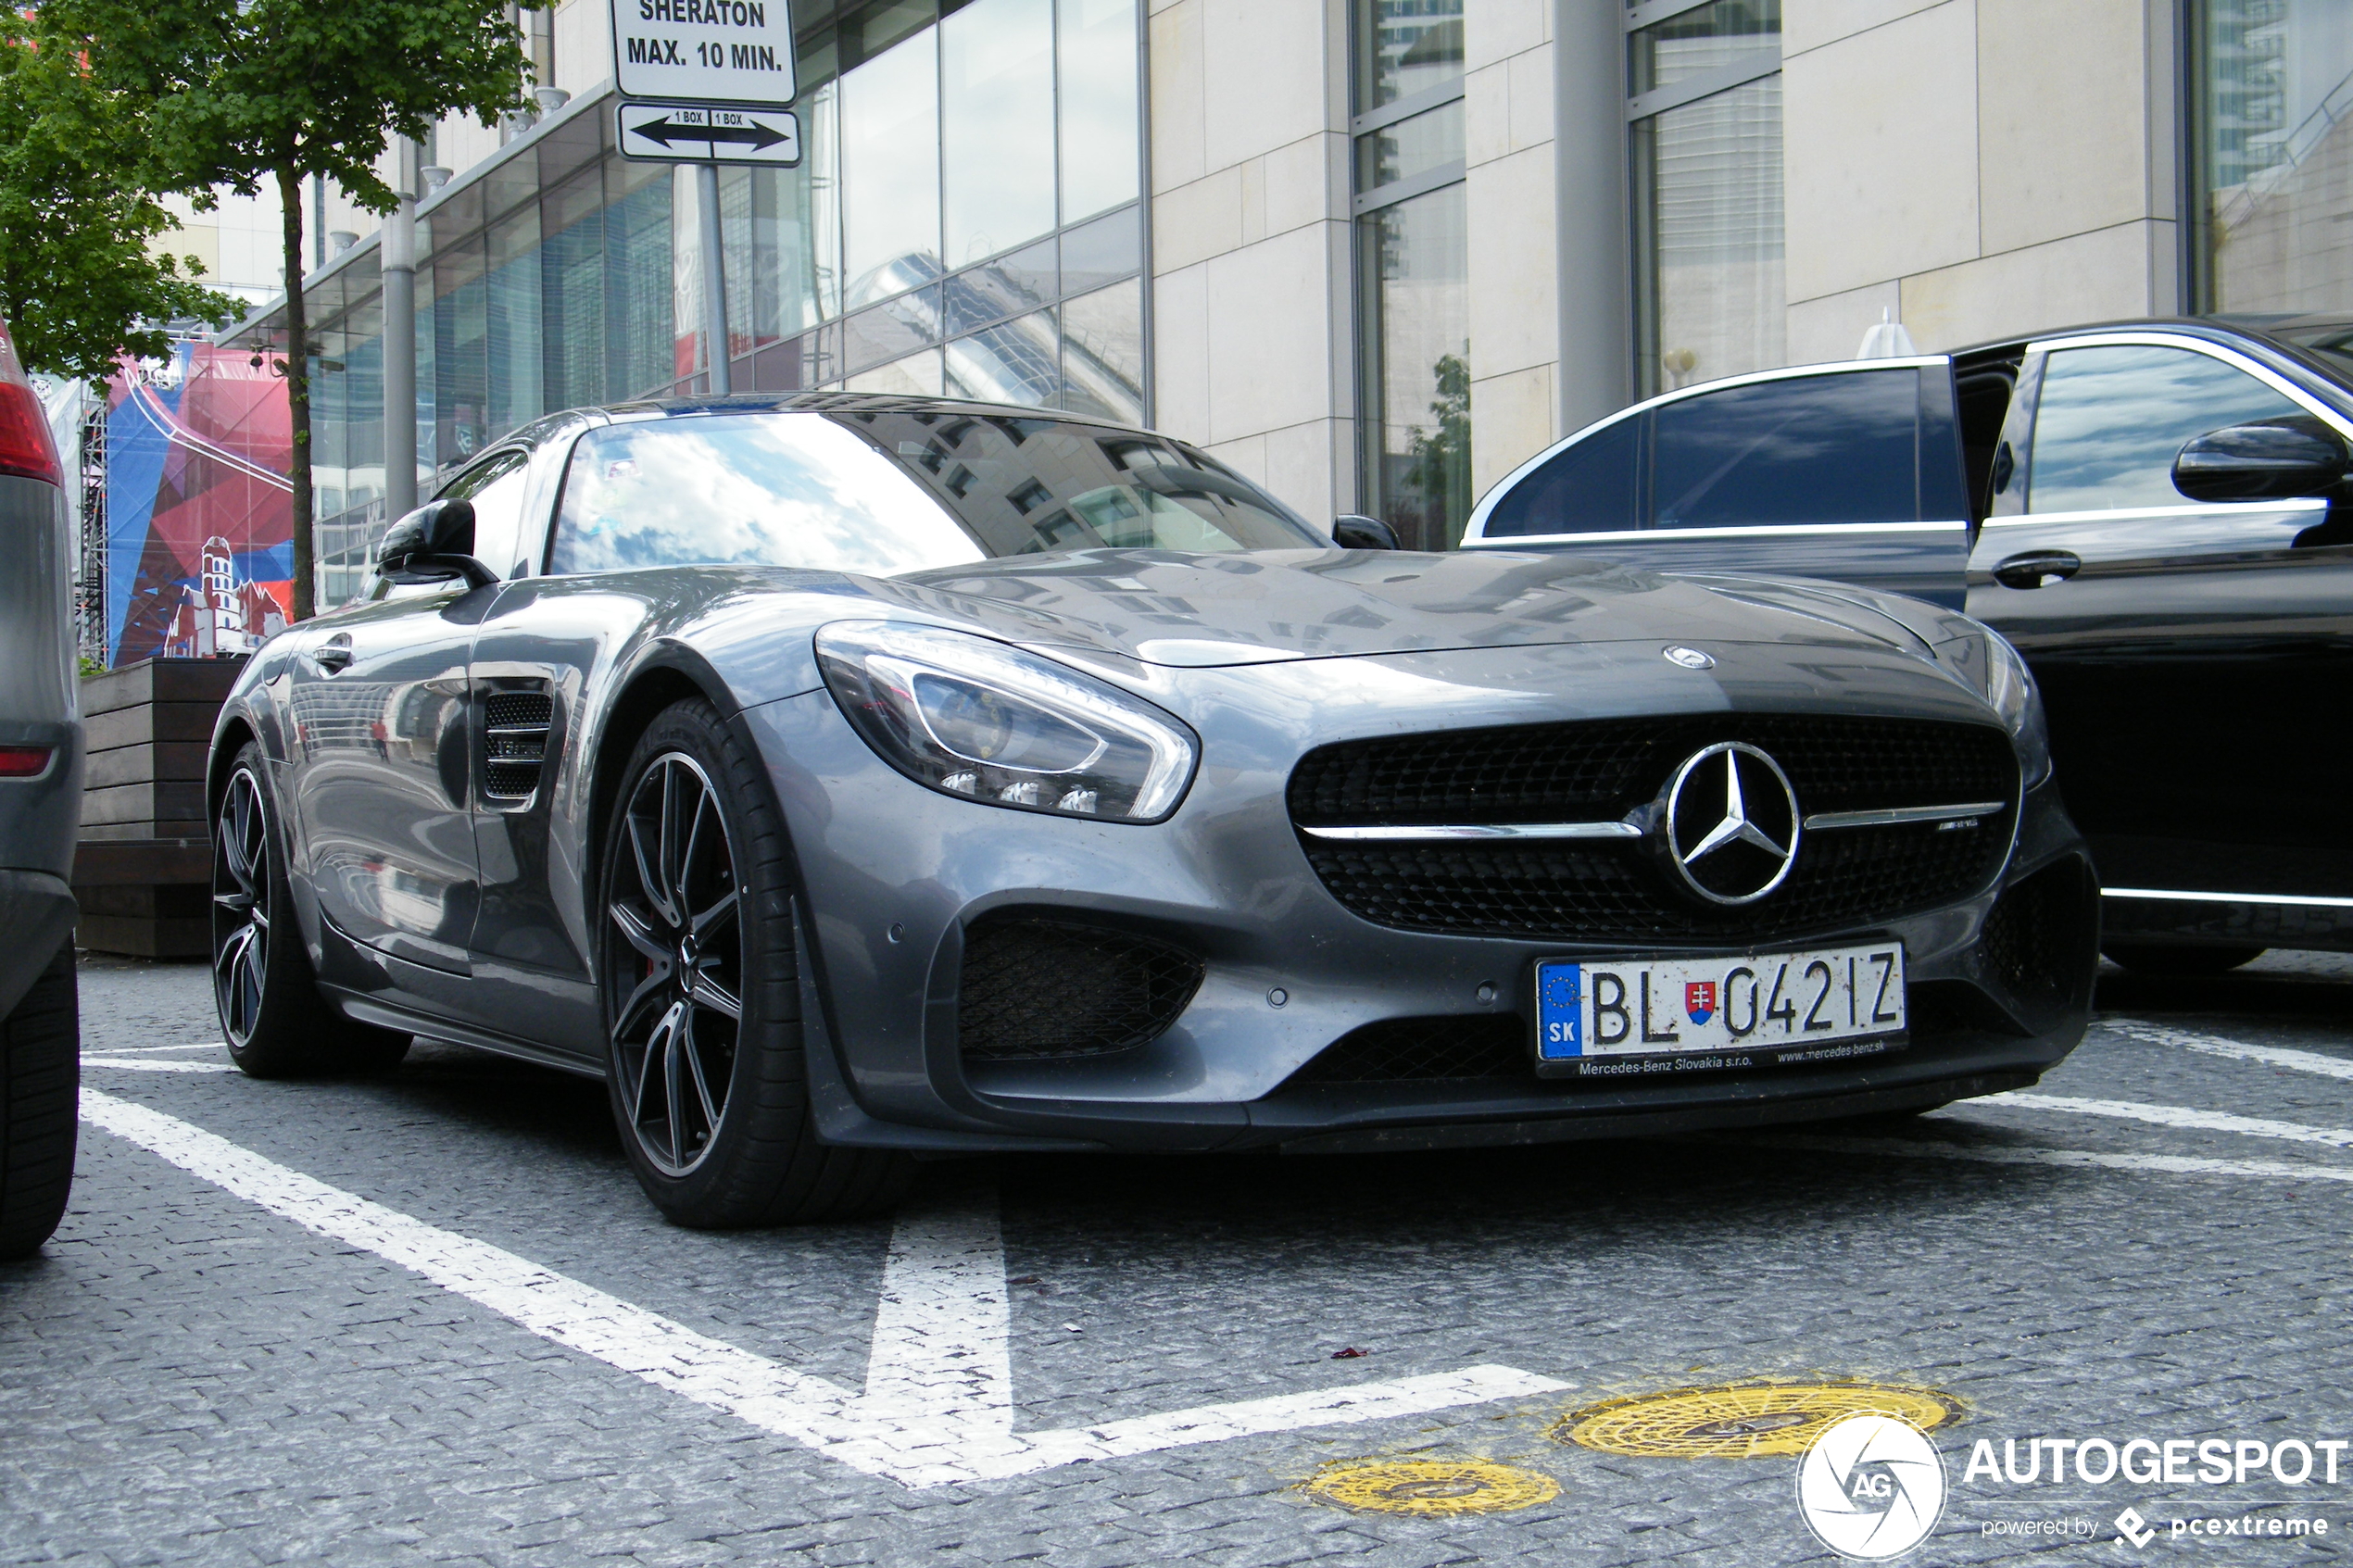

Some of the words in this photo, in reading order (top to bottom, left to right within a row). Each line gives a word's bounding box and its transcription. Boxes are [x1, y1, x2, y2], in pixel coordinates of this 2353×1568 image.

[639, 0, 765, 28] SHERATON
[627, 37, 686, 66] MAX.
[697, 42, 724, 69] 10
[731, 44, 782, 72] MIN.
[675, 111, 680, 122] 1
[684, 111, 703, 124] BOX
[715, 113, 720, 124] 1
[724, 114, 743, 126] BOX
[1592, 971, 1679, 1046] BL
[1549, 1022, 1576, 1043] SK
[1778, 1040, 1885, 1063] www.mercedes-benz.sk
[1579, 1060, 1671, 1075] Mercedes-Benz
[1675, 1056, 1722, 1071] Slovakia
[1725, 1057, 1753, 1067] s.r.o.
